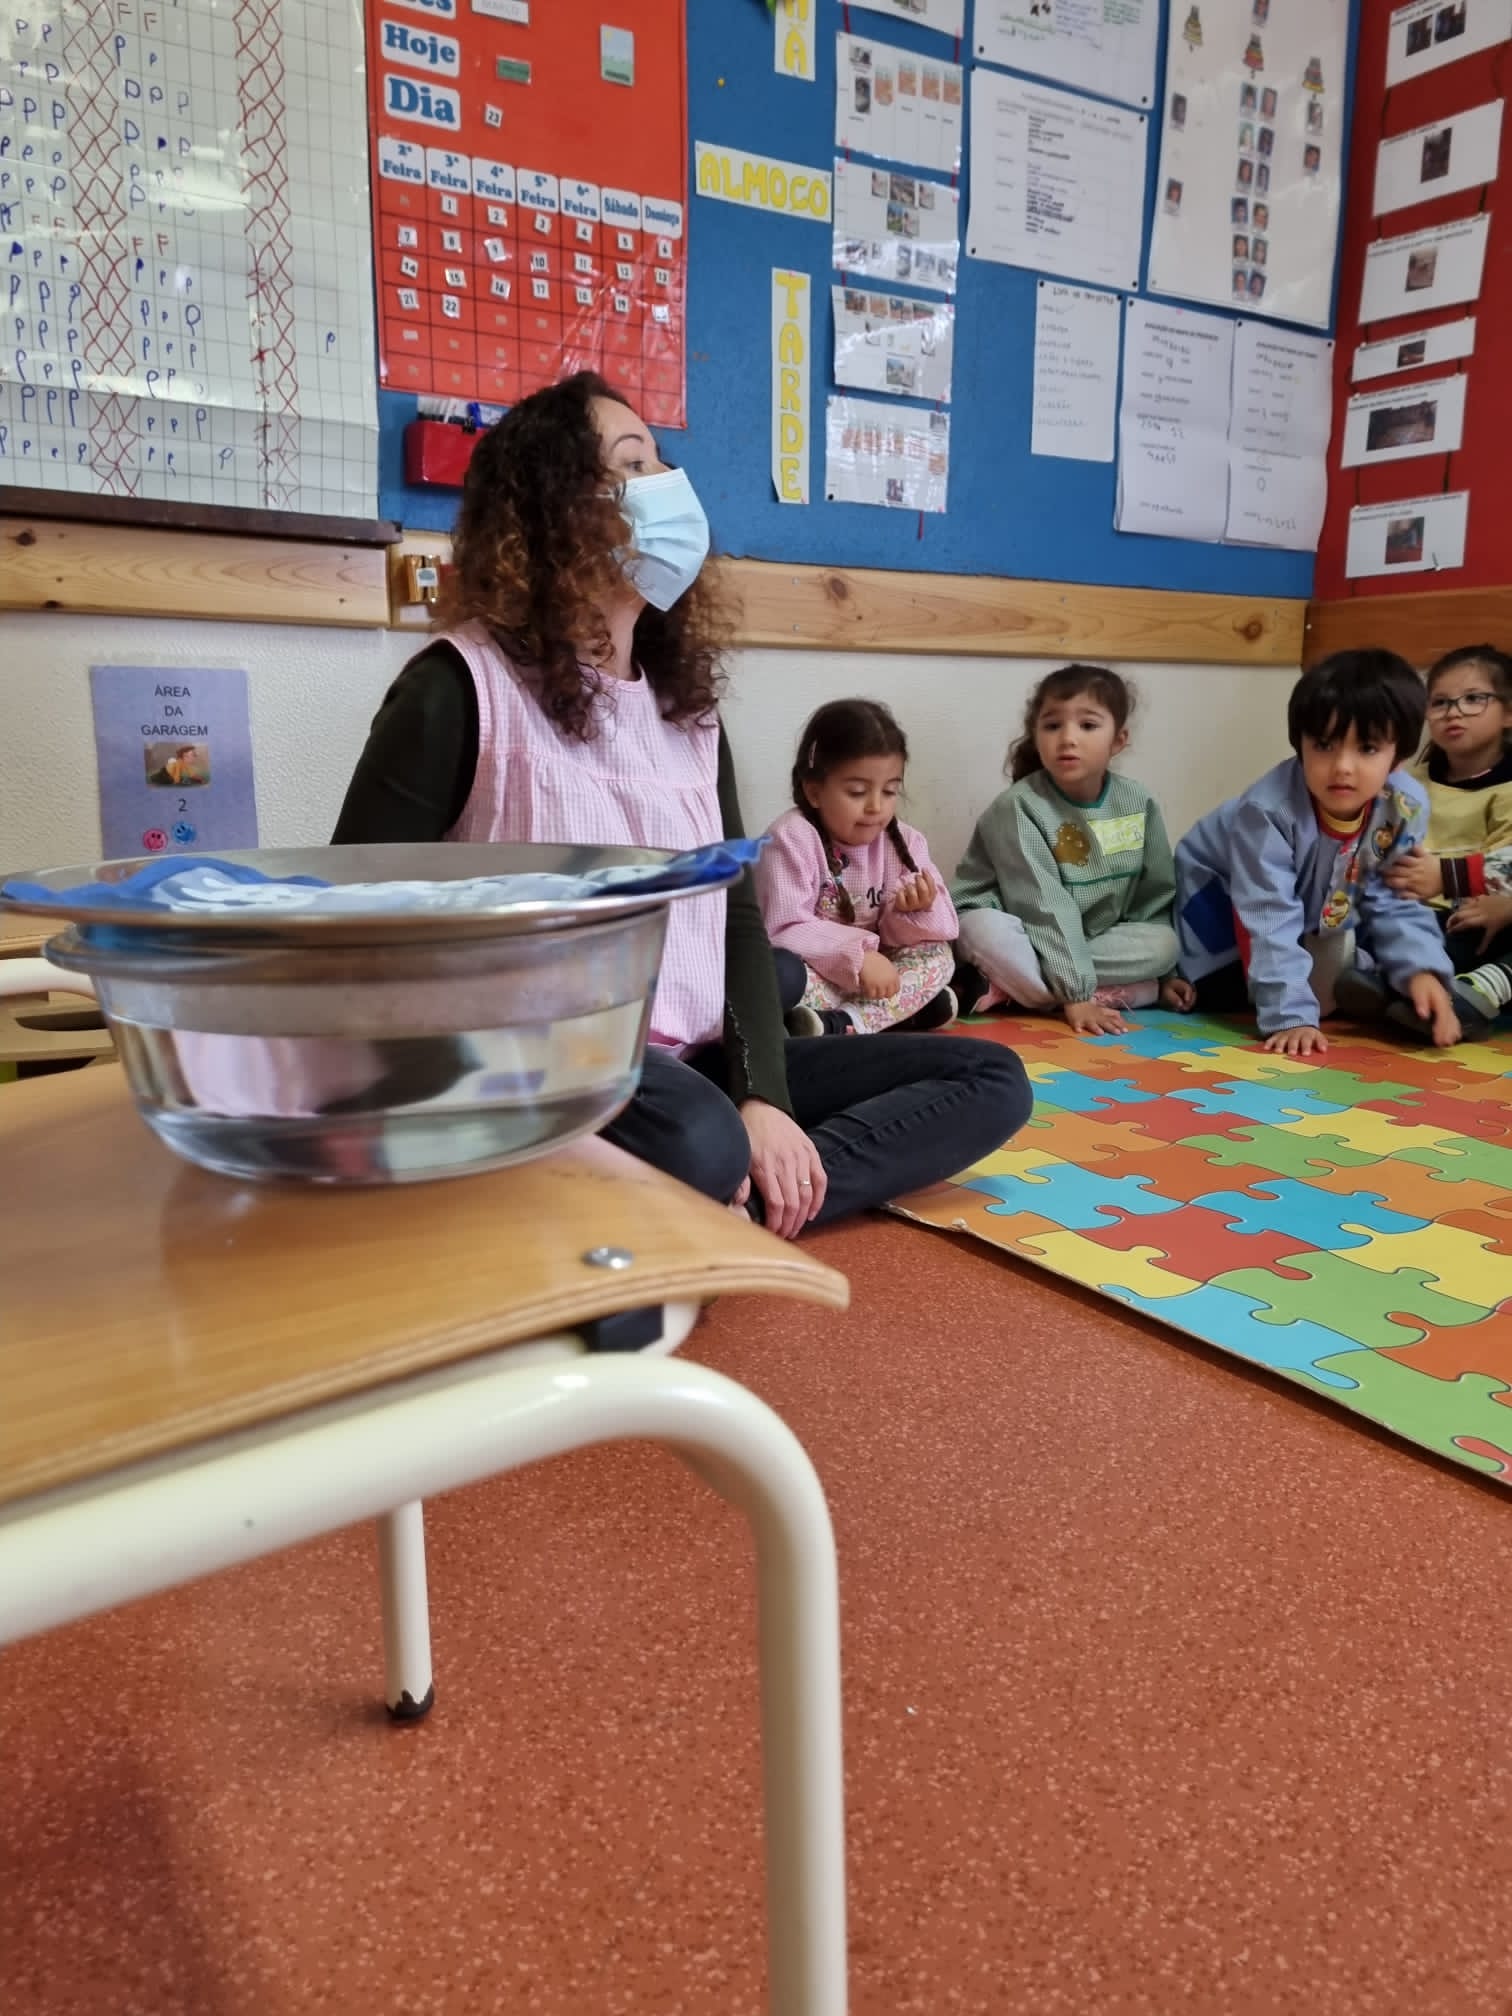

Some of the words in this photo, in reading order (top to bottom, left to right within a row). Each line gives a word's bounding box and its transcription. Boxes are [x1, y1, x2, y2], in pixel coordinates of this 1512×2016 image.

[384, 23, 456, 64] Hoje
[388, 77, 456, 124] Dia
[383, 159, 422, 180] Feira
[430, 169, 468, 189] Feira
[476, 179, 513, 198] Feira
[520, 189, 556, 208] Feira
[563, 199, 597, 217] Feira
[774, 271, 807, 501] TARDE
[141, 725, 208, 737] GARAGEM
[164, 705, 184, 717] DA
[178, 799, 188, 812] 2
